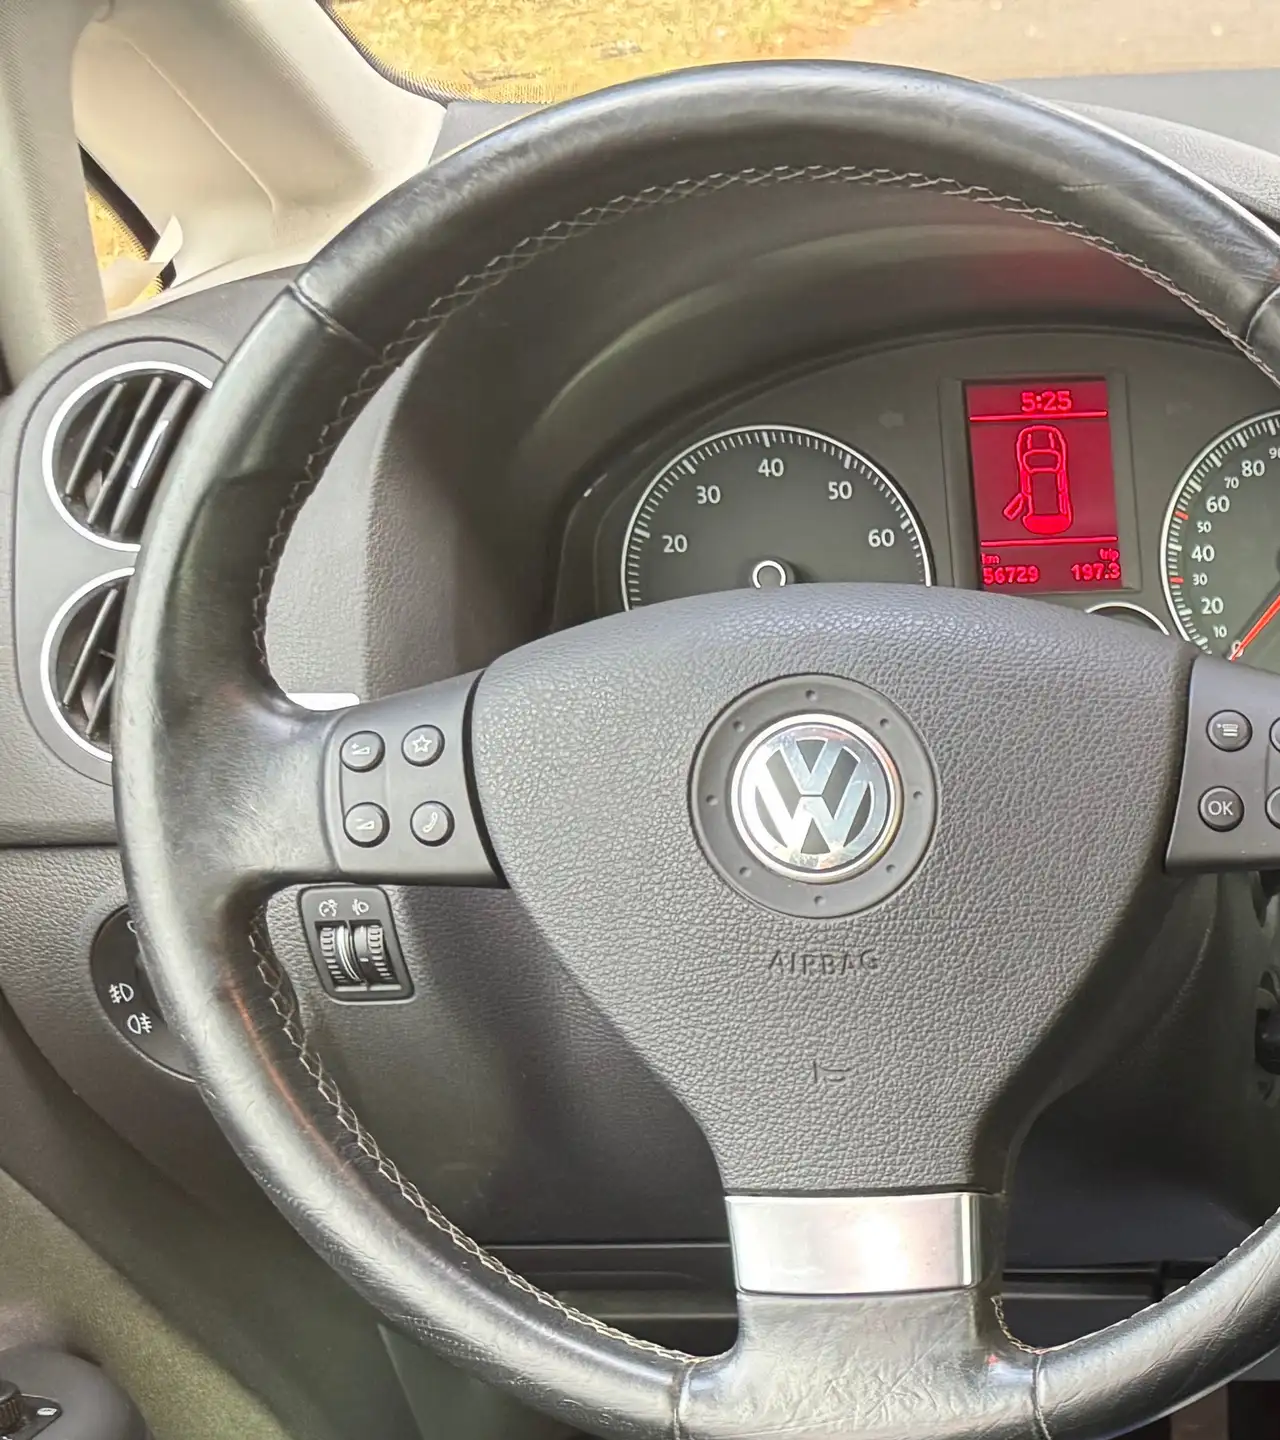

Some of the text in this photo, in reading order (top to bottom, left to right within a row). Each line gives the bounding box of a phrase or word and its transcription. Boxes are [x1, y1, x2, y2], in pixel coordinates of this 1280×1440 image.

[1020, 390, 1072, 412] 5:25
[757, 458, 785, 477] 40
[1240, 460, 1266, 478] 80
[827, 481, 853, 500] 50
[1223, 476, 1240, 489] 70
[695, 485, 722, 504] 30
[1205, 495, 1231, 514] 60
[1196, 520, 1213, 534] 50
[661, 534, 688, 553] 20
[867, 529, 895, 549] 60
[981, 554, 1000, 564] km
[1099, 548, 1120, 561] trip
[1191, 544, 1215, 563] 40
[982, 565, 1039, 584] 56729
[1071, 562, 1121, 581] 197.3
[1192, 573, 1208, 586] 30
[1201, 598, 1224, 615] 20
[1213, 624, 1228, 639] 10
[1207, 800, 1233, 816] OK
[767, 948, 879, 977] AIRBAG
